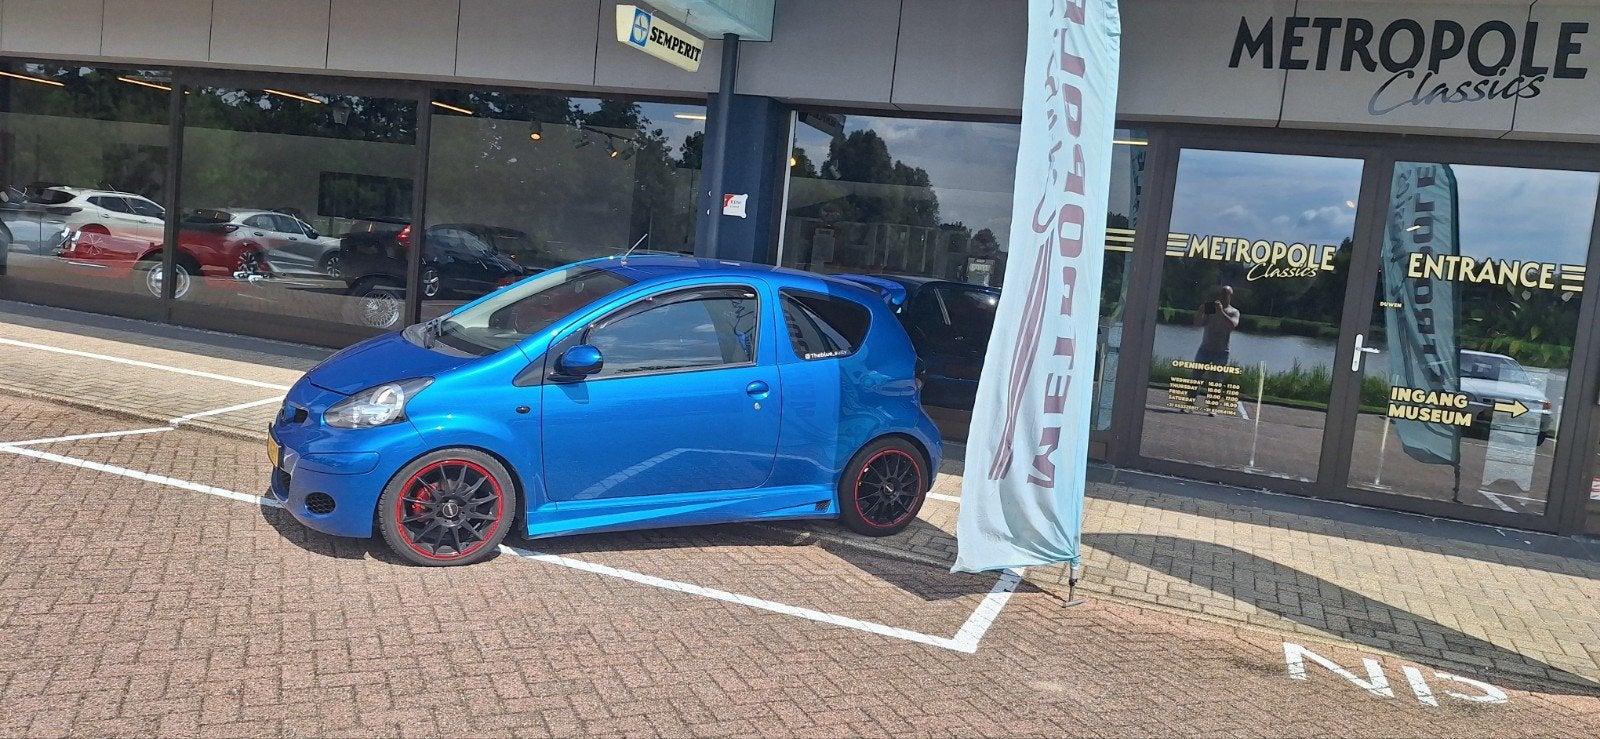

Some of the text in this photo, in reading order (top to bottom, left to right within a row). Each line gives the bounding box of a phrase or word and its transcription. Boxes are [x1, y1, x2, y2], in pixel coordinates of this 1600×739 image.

[649, 26, 701, 61] SEMPERIT
[1228, 16, 1589, 79] METROPOLE
[1367, 67, 1545, 116] Classics
[1188, 234, 1336, 271] METROPOLE
[1246, 262, 1318, 282] Classics
[1408, 252, 1556, 290] ENTRANCE
[1172, 360, 1242, 374] OPENINGHOURS:
[1169, 382, 1198, 391] THURSDAY
[1170, 376, 1204, 385] WEDNESDAY
[1168, 394, 1196, 403] SATURDAY
[1391, 387, 1468, 409] INGANG
[1388, 403, 1472, 427] MUSEUM
